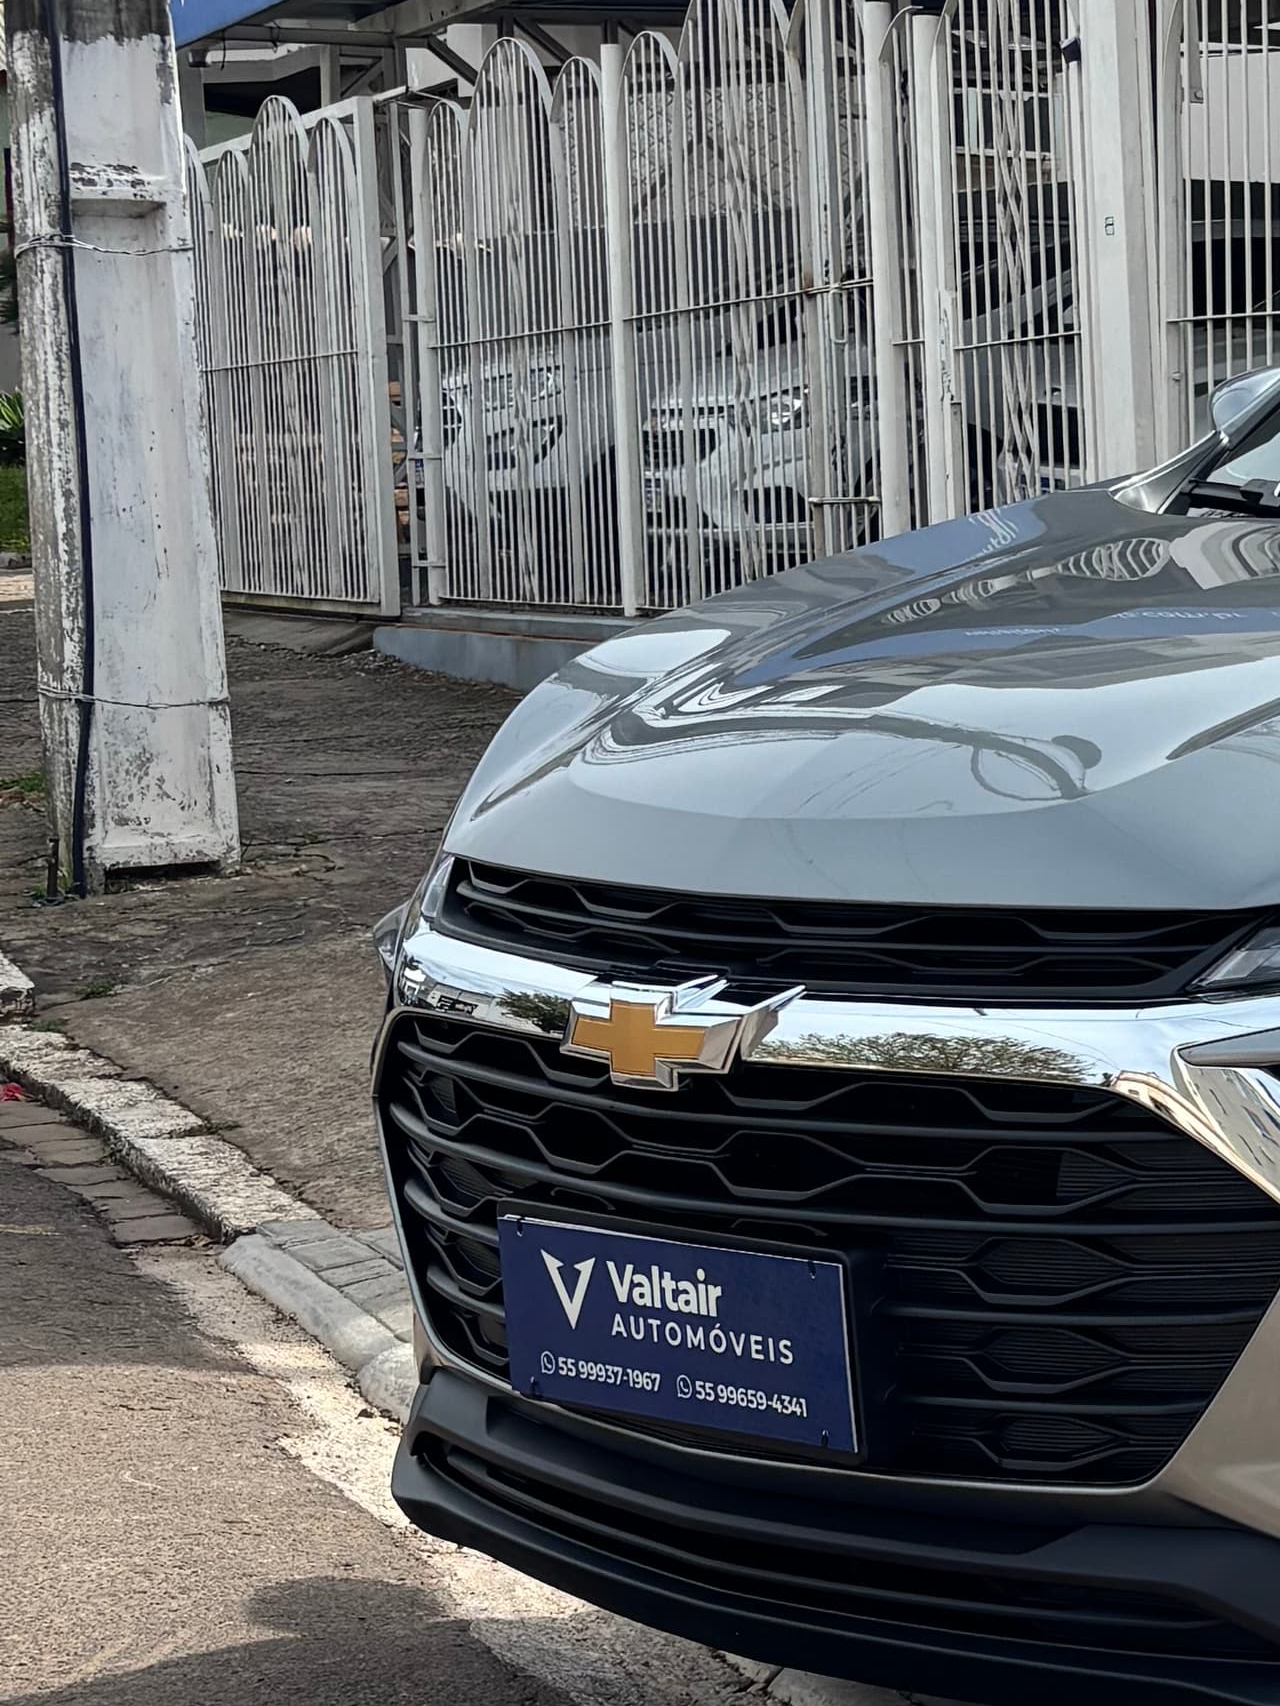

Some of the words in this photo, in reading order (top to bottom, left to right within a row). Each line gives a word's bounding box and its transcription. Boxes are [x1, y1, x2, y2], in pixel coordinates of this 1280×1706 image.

[606, 1261, 722, 1318] Valtair
[611, 1313, 794, 1365] AUTOMÓVEIS
[557, 1356, 576, 1377] 55
[578, 1360, 661, 1392] 99937-1967
[695, 1380, 715, 1401] 55
[717, 1385, 808, 1418] 99659-4341
